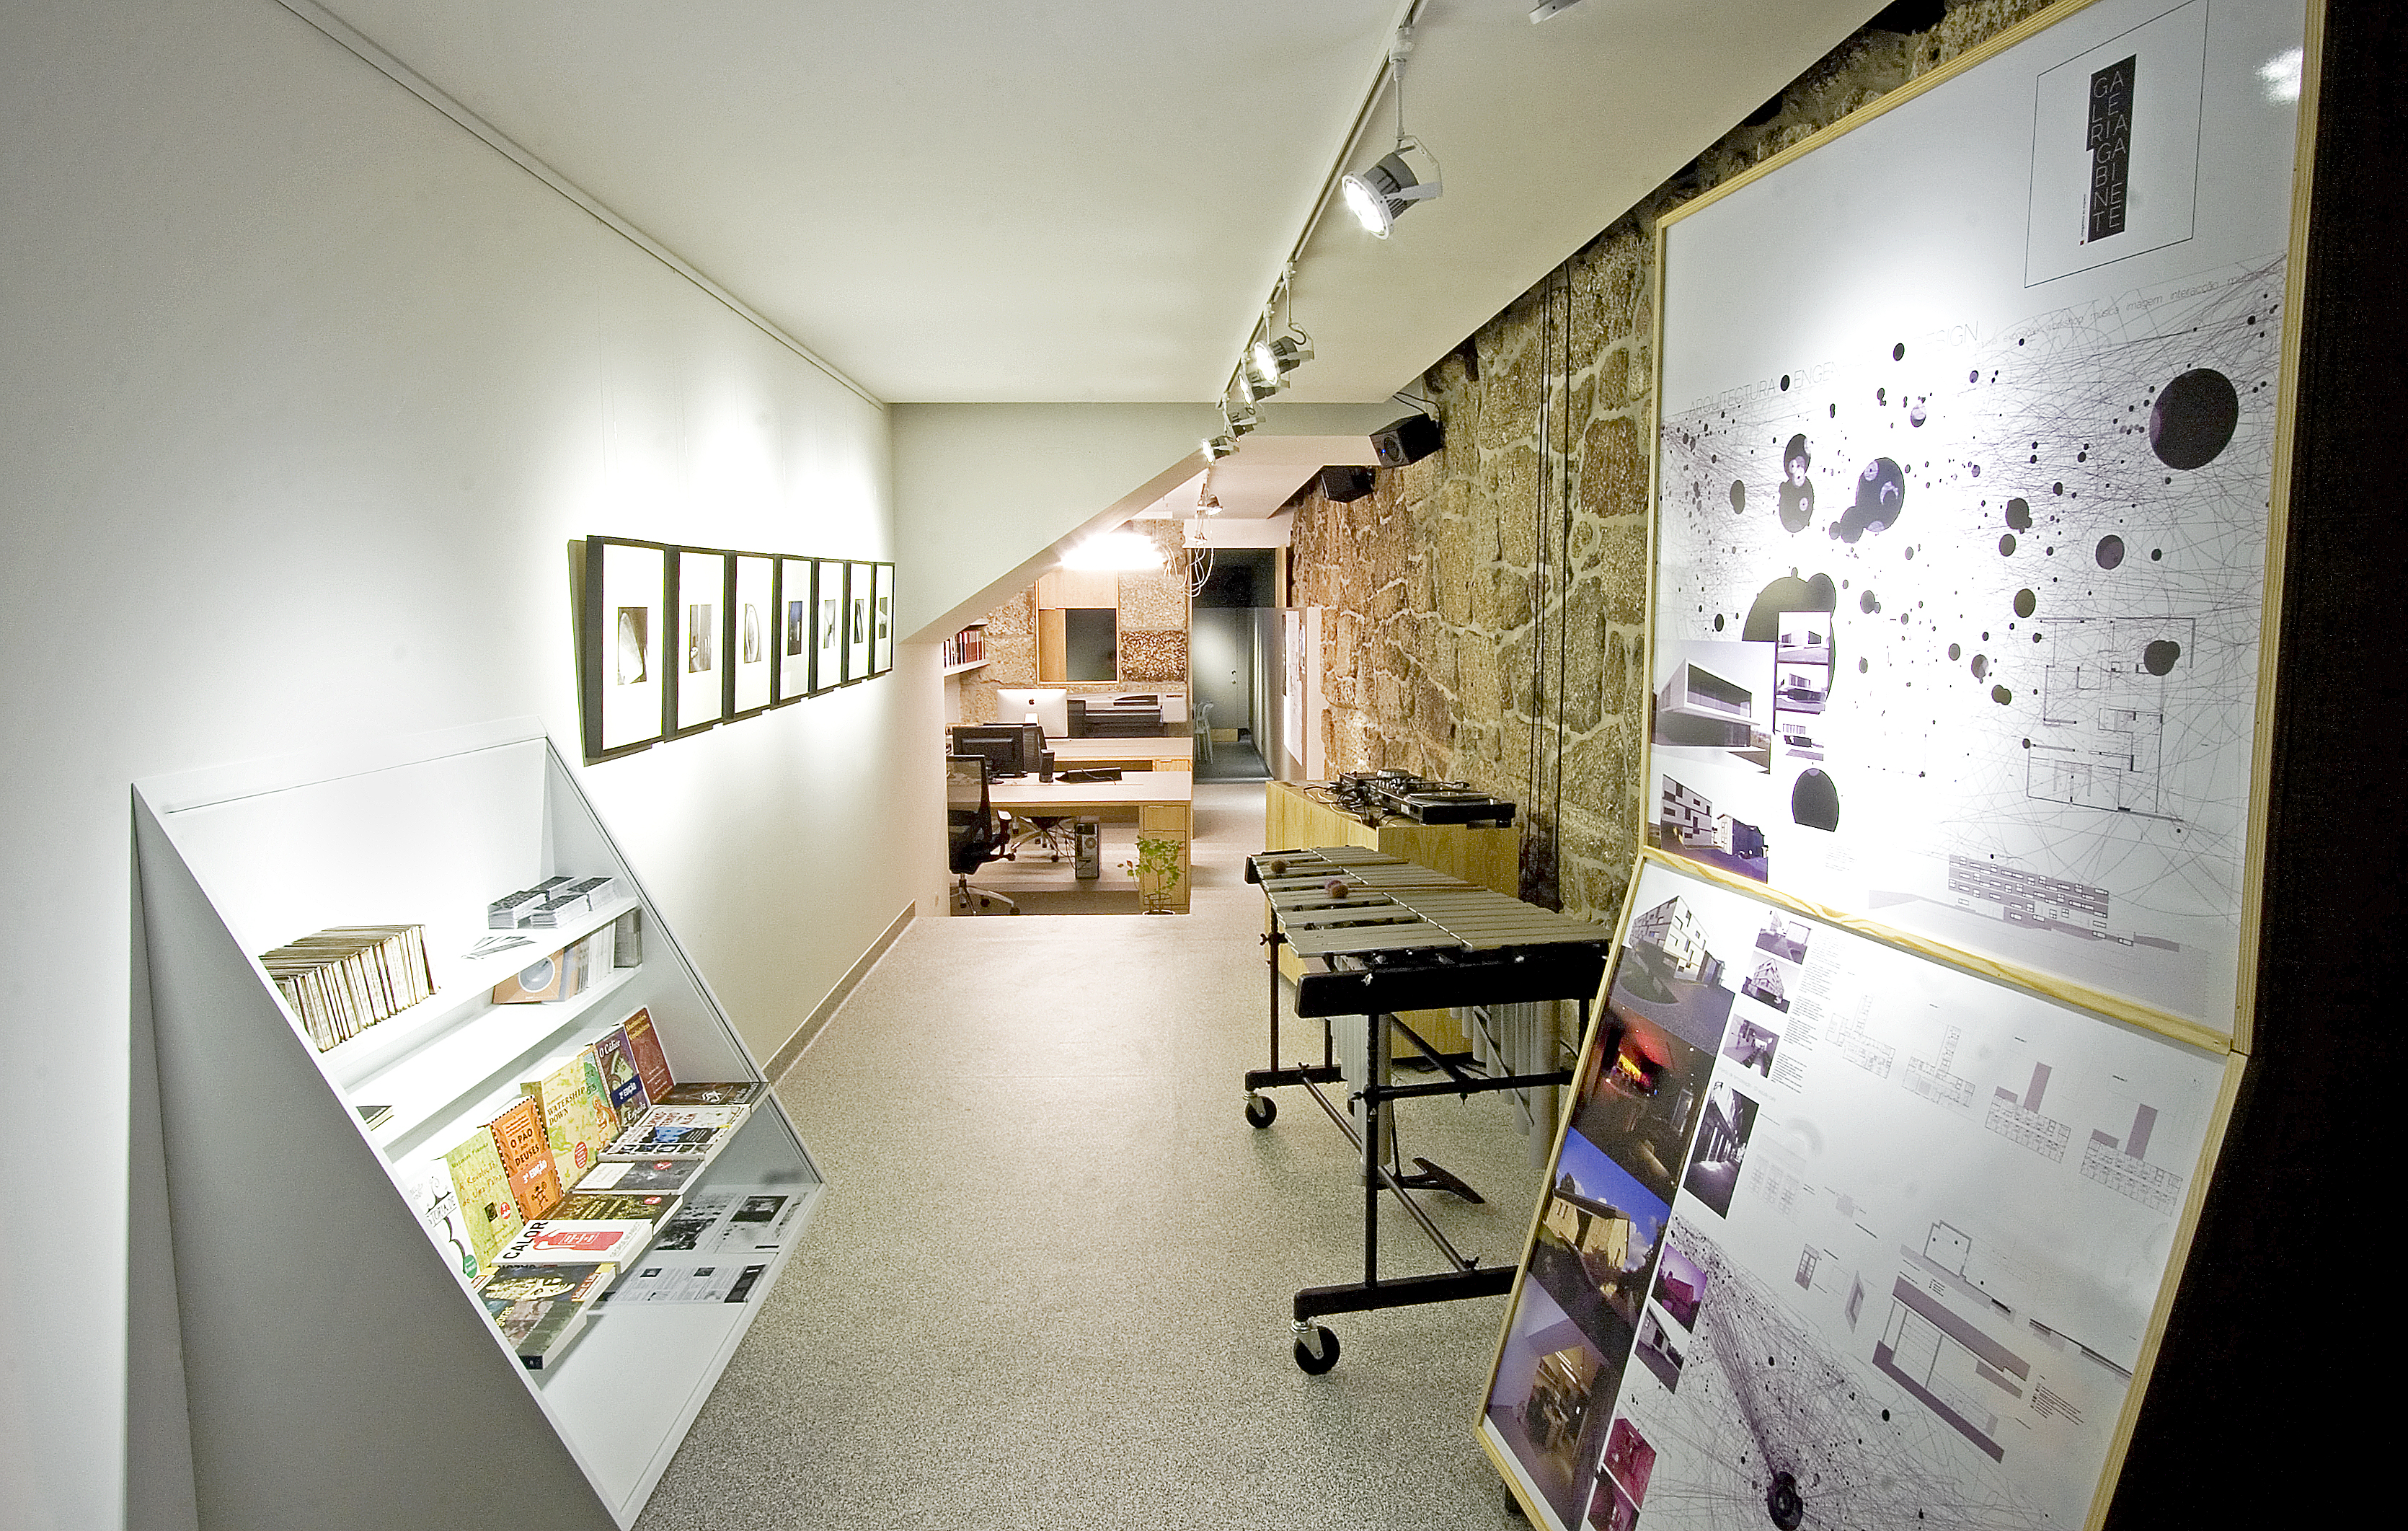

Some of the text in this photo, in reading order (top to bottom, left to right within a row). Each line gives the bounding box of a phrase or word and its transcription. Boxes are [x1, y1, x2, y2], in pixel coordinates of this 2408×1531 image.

[1688, 377, 1776, 416] ARQUITECTURA
[547, 1086, 585, 1116] WATERSHIP
[549, 1108, 569, 1126] DOWN
[510, 1139, 517, 1149] O
[515, 1144, 539, 1167] DEUSES
[503, 1222, 549, 1259] CALOR
